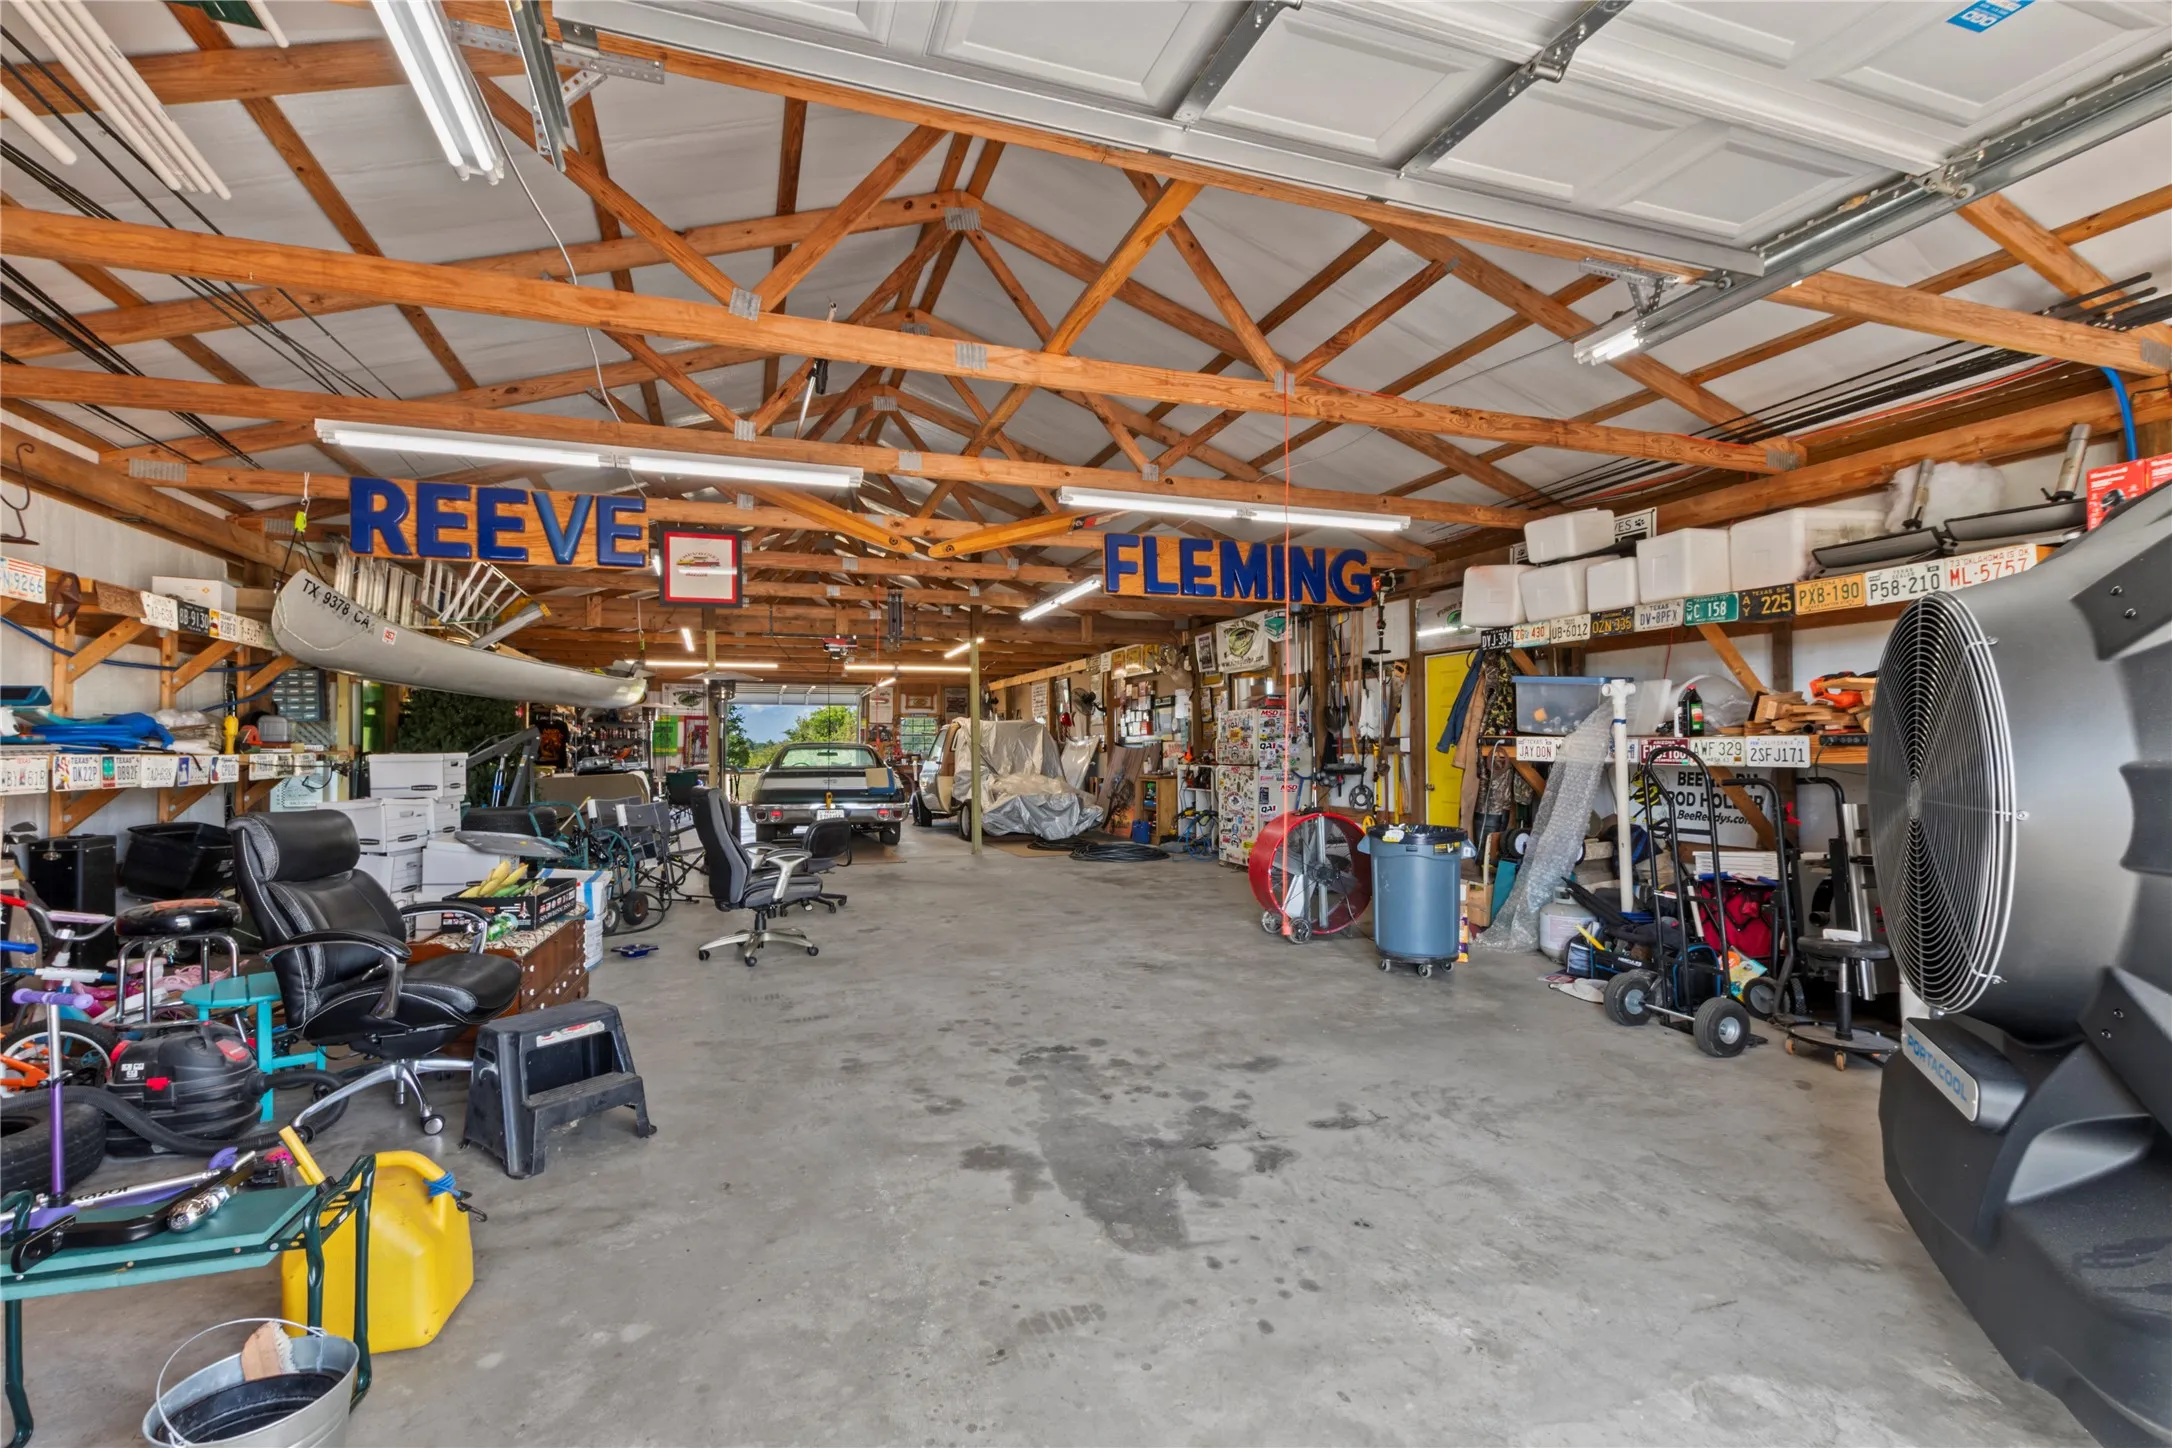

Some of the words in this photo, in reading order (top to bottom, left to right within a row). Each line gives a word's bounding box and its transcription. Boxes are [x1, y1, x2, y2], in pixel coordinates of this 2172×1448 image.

[350, 477, 646, 568] REEVE
[1105, 533, 1373, 605] FLEMING
[1752, 588, 1773, 596] TEXAS
[1799, 582, 1859, 606] PXB-190
[1870, 573, 1940, 600] P58-210
[302, 578, 320, 598] TX
[322, 591, 351, 616] 9378
[353, 610, 371, 629] CA
[1650, 603, 1669, 611] TEXAS
[1708, 601, 1727, 617] 158
[1761, 593, 1792, 614] 225
[1531, 626, 1545, 638] 430
[1551, 623, 1588, 640] UB-6012
[1614, 617, 1632, 631] 335
[1482, 631, 1512, 649] DYJ-384
[1519, 746, 1534, 757] JAY
[1536, 746, 1552, 758] DON
[1693, 742, 1715, 756] AWF
[1718, 741, 1742, 756] 329
[1677, 771, 1703, 786] BEE
[1907, 1034, 1967, 1102] PORTACOOL
